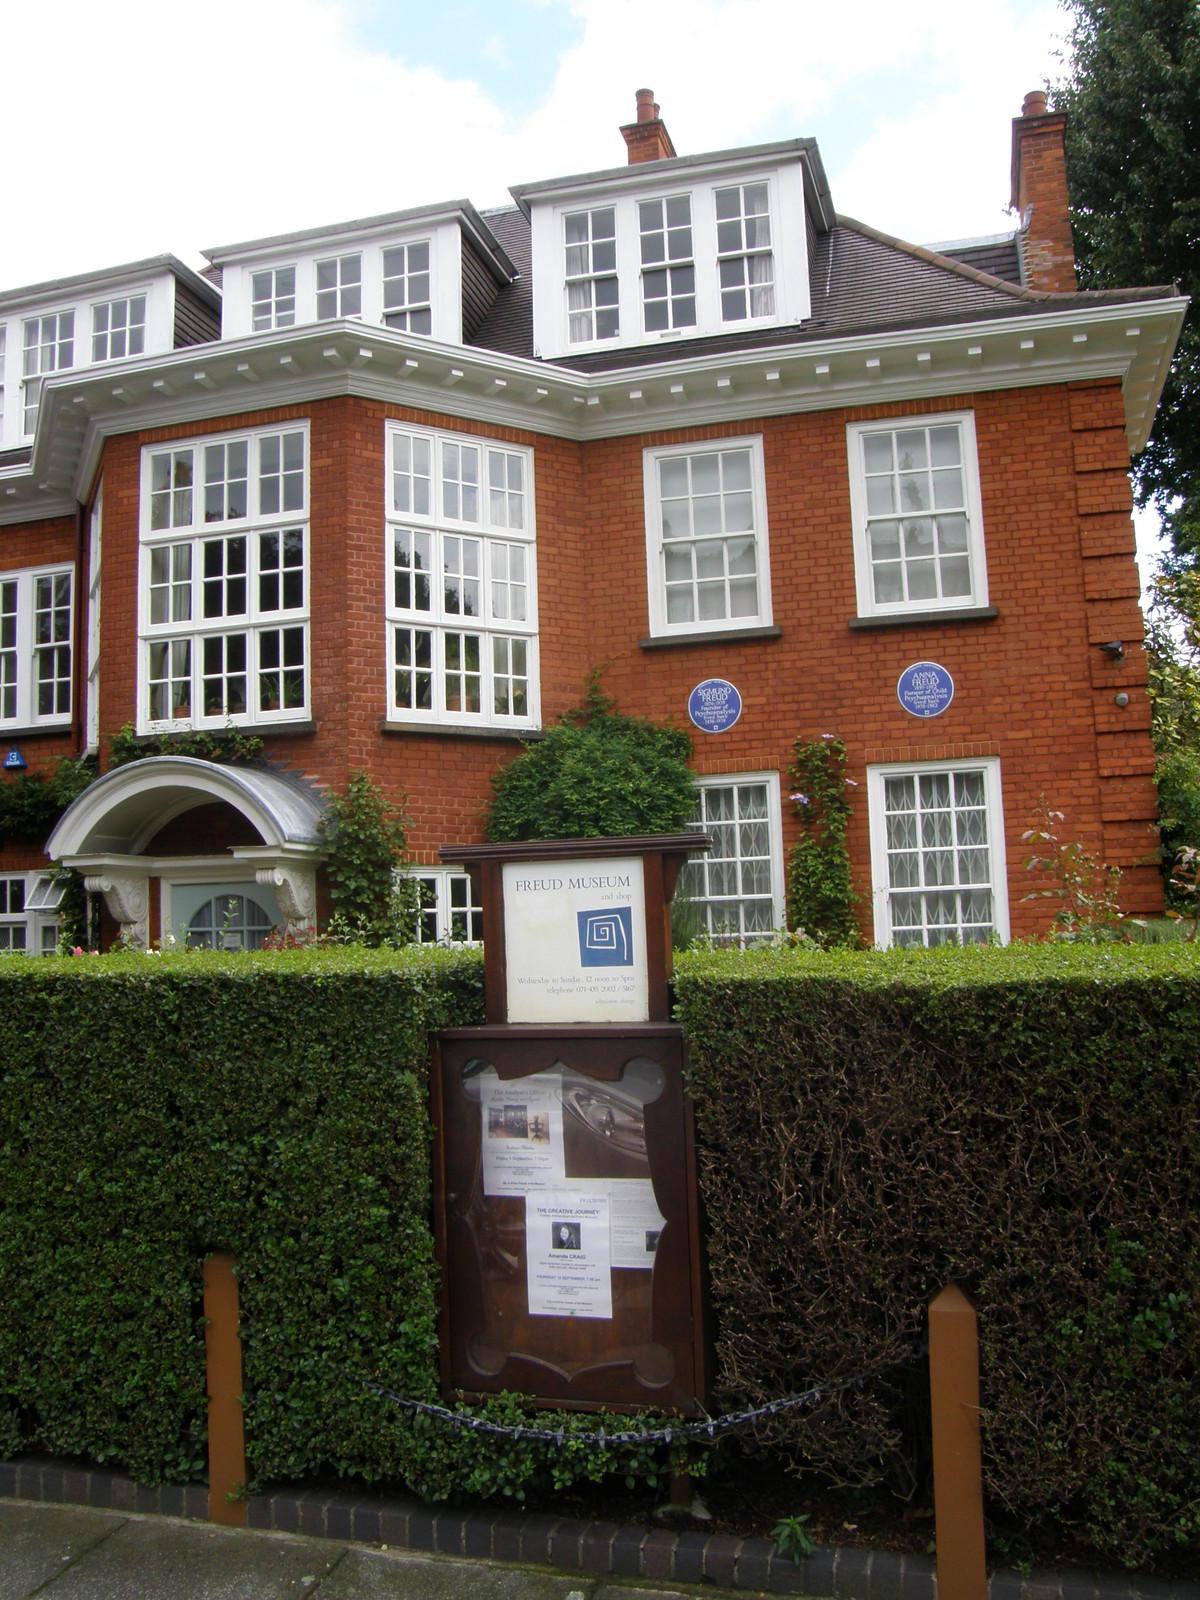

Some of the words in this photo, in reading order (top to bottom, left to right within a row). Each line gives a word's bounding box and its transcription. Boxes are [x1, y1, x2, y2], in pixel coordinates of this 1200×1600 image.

[912, 671, 938, 680] ANNA
[912, 677, 940, 687] FREUD
[697, 687, 732, 696] SIGMUND
[702, 693, 728, 701] FREUD
[904, 693, 948, 703] Psychoanalysis
[694, 707, 736, 718] Psychoanalysis
[515, 879, 563, 892] FREUD
[568, 875, 631, 890] MUSEUM
[600, 892, 614, 901] and
[616, 891, 632, 902] shop
[517, 977, 550, 985] Wednesday
[551, 976, 559, 984] to
[560, 975, 584, 985] Sunday,
[620, 974, 635, 983] 5pm
[546, 986, 574, 994] telephone
[576, 985, 599, 994] 071-435
[600, 984, 617, 993] 2002
